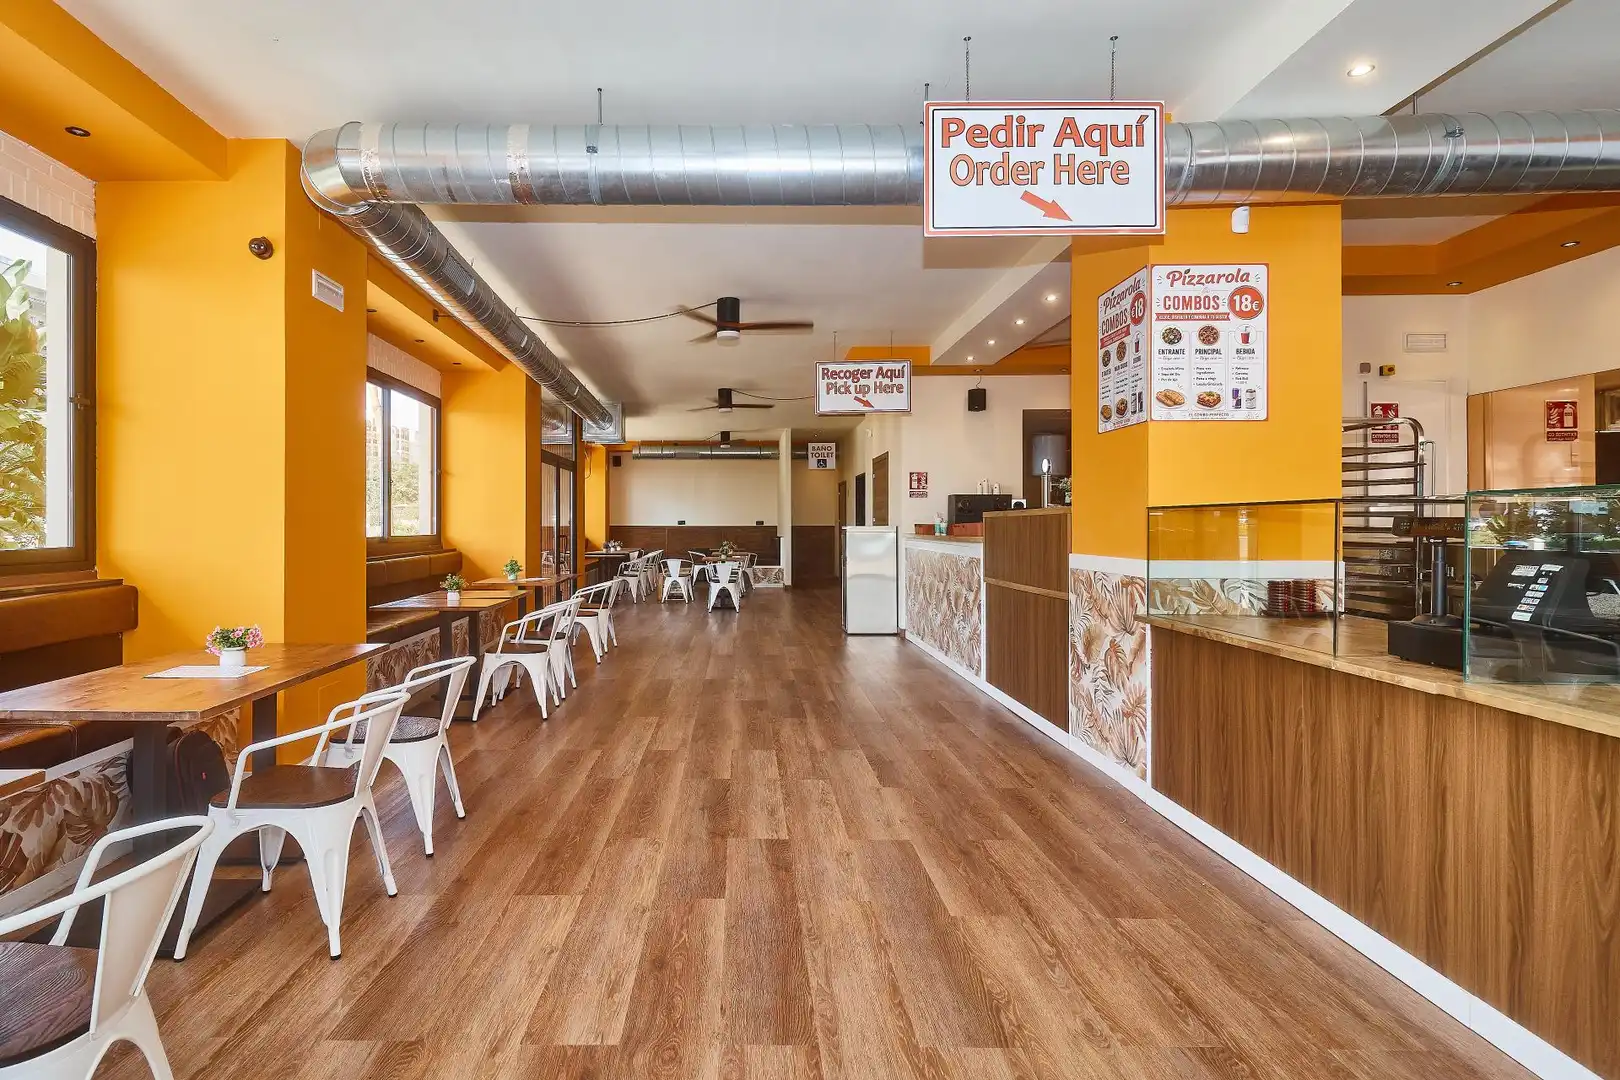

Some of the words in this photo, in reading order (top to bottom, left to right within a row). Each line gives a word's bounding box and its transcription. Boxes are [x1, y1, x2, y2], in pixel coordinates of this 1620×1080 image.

[941, 115, 1044, 148] Pedir
[1053, 114, 1149, 156] Aquí
[949, 152, 1045, 186] Order
[1053, 153, 1130, 185] Here
[1166, 268, 1251, 287] Pizzarola
[1103, 277, 1141, 315] Pizzarola
[1163, 295, 1220, 310] COMBOS
[1233, 294, 1260, 312] 18€
[1101, 308, 1128, 336] COMBOS
[821, 367, 873, 383] Recoger
[876, 365, 906, 382] Aquí
[826, 381, 852, 395] Pick
[854, 384, 870, 397] up
[874, 381, 904, 395] Here
